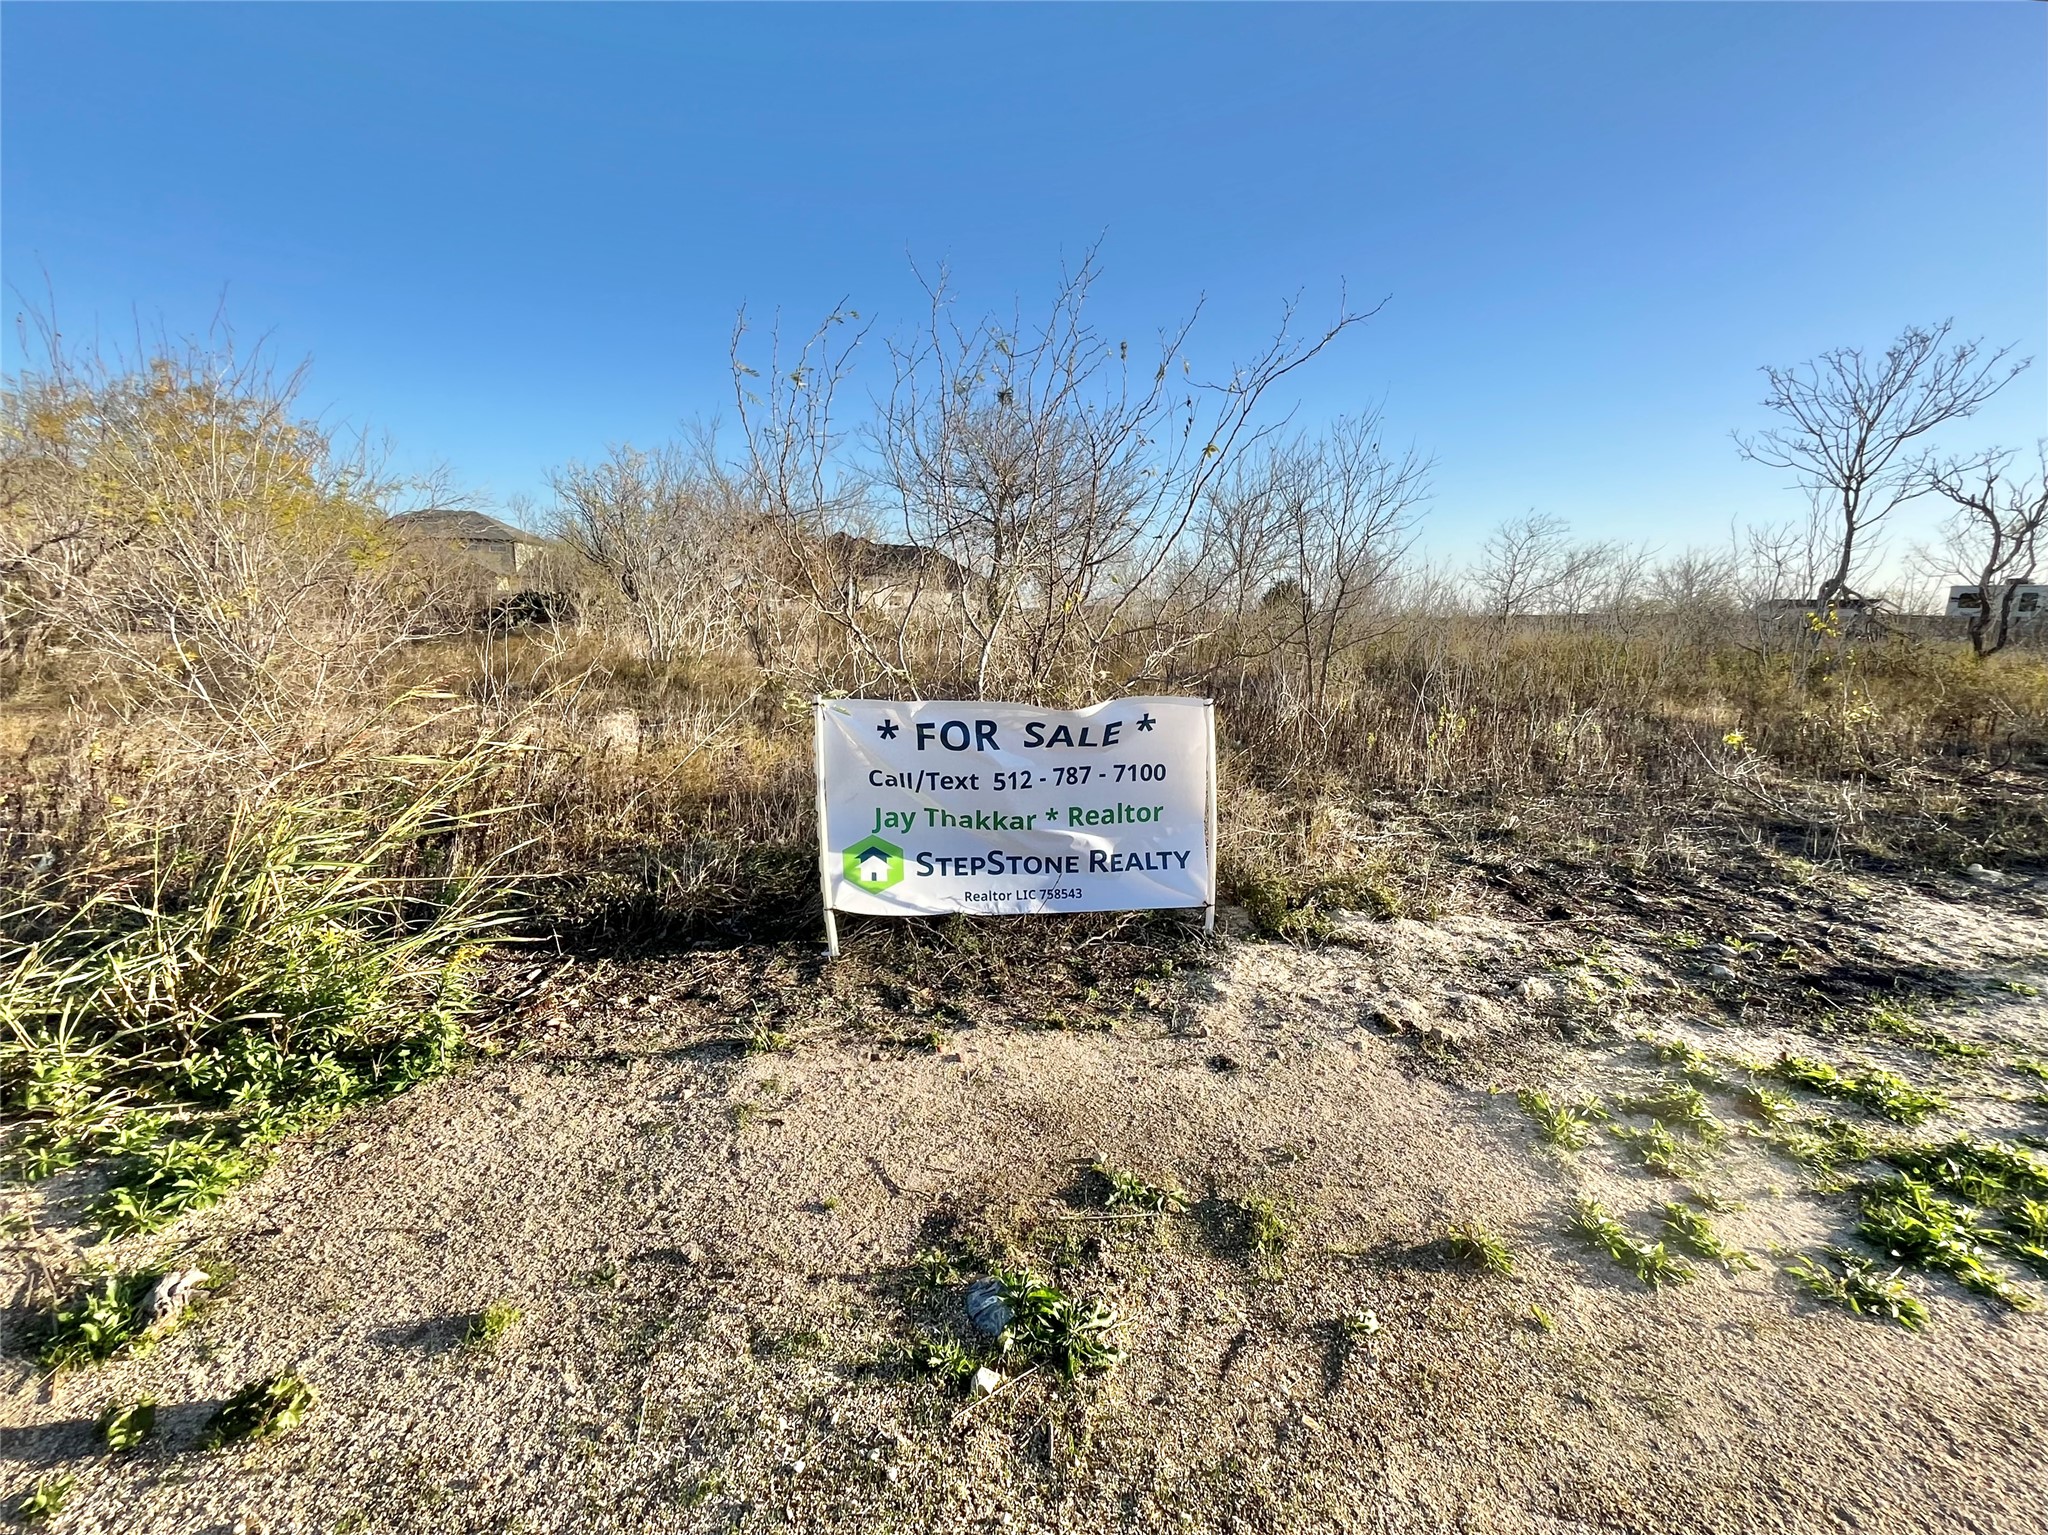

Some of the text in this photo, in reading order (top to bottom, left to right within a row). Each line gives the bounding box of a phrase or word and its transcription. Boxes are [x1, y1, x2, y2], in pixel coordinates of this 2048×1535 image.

[916, 719, 1123, 752] FOR SALE
[868, 769, 979, 793] Call/Text
[993, 770, 1033, 791] 512
[1053, 766, 1092, 786] 787
[1113, 763, 1166, 783] 7100
[872, 802, 1164, 834] Jay Thakkar Realtor
[964, 888, 1082, 902] Realtor LIC 758543
